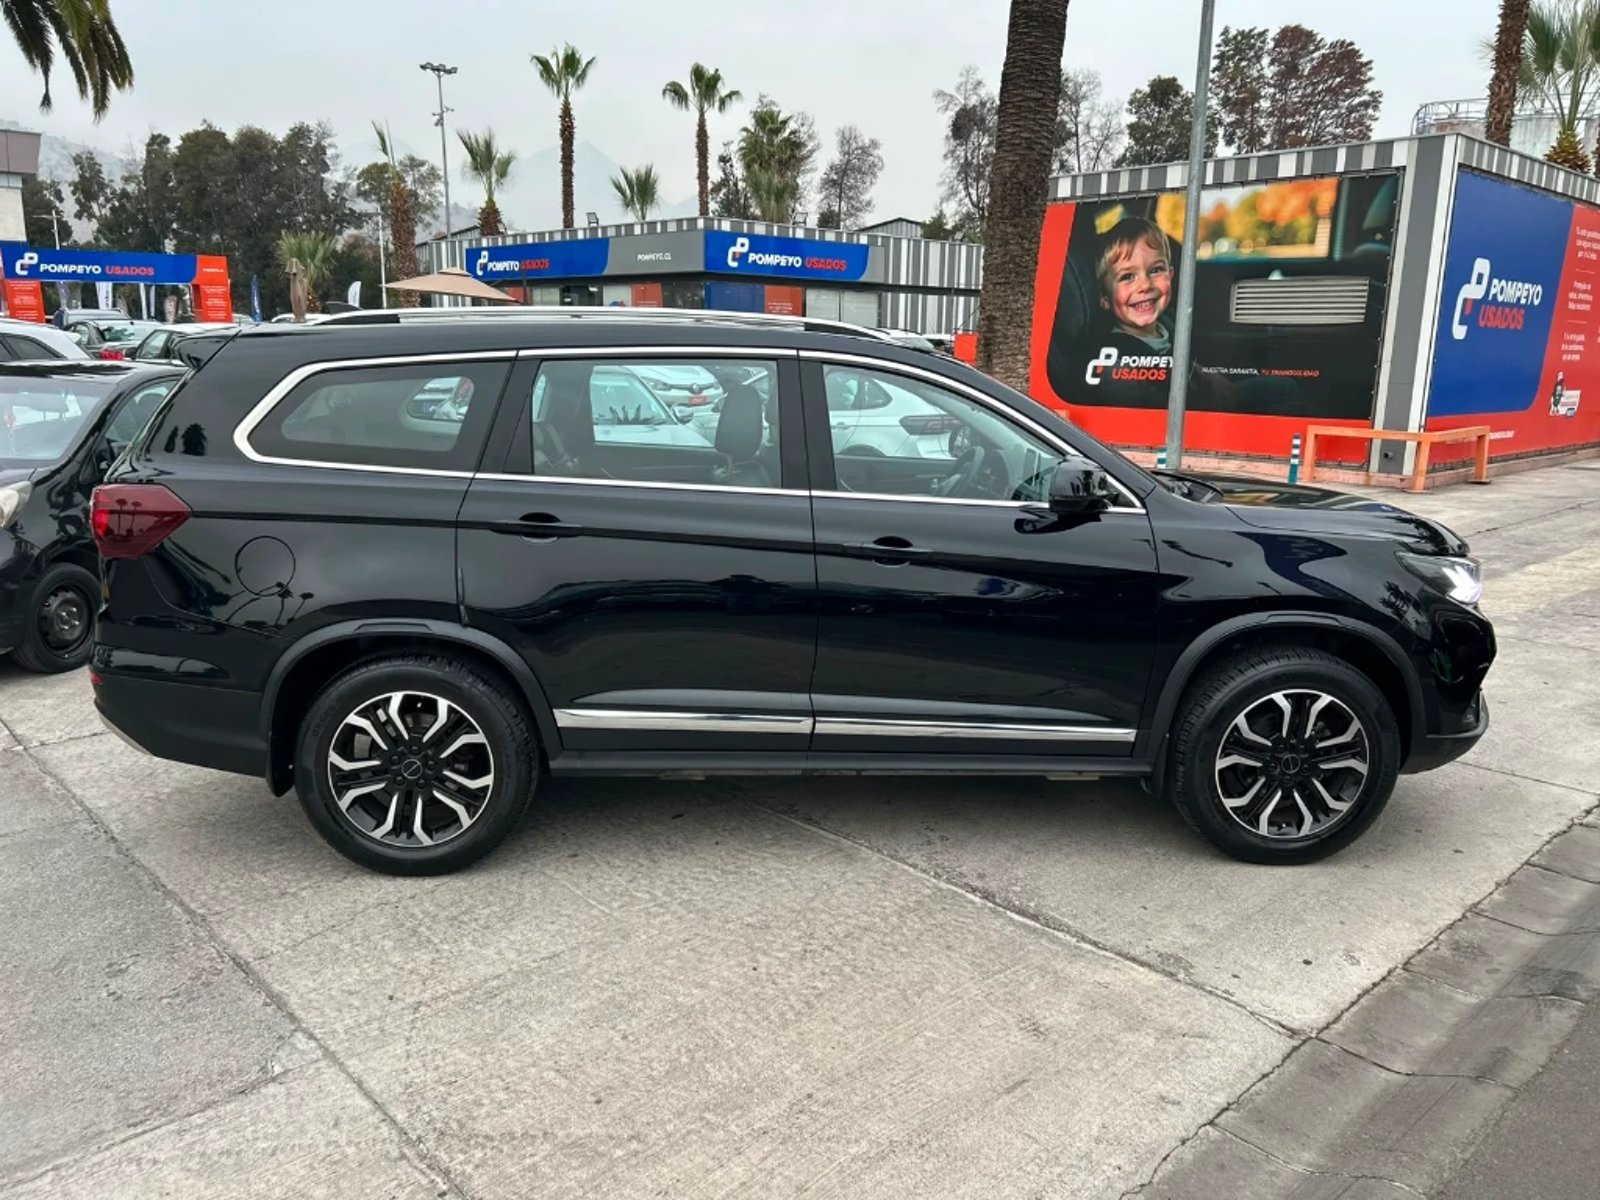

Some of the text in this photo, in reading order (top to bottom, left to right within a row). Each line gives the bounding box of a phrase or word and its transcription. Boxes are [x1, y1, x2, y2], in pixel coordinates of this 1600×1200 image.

[487, 258, 550, 272] POMPEYO USADOS
[749, 253, 846, 271] POMPEYO USADOS
[39, 263, 155, 276] POMPEYO USADOS
[1488, 278, 1542, 305] POMPEYO
[1478, 304, 1524, 330] USADOS
[1120, 356, 1174, 368] POMPEY
[1112, 368, 1168, 380] USADOS
